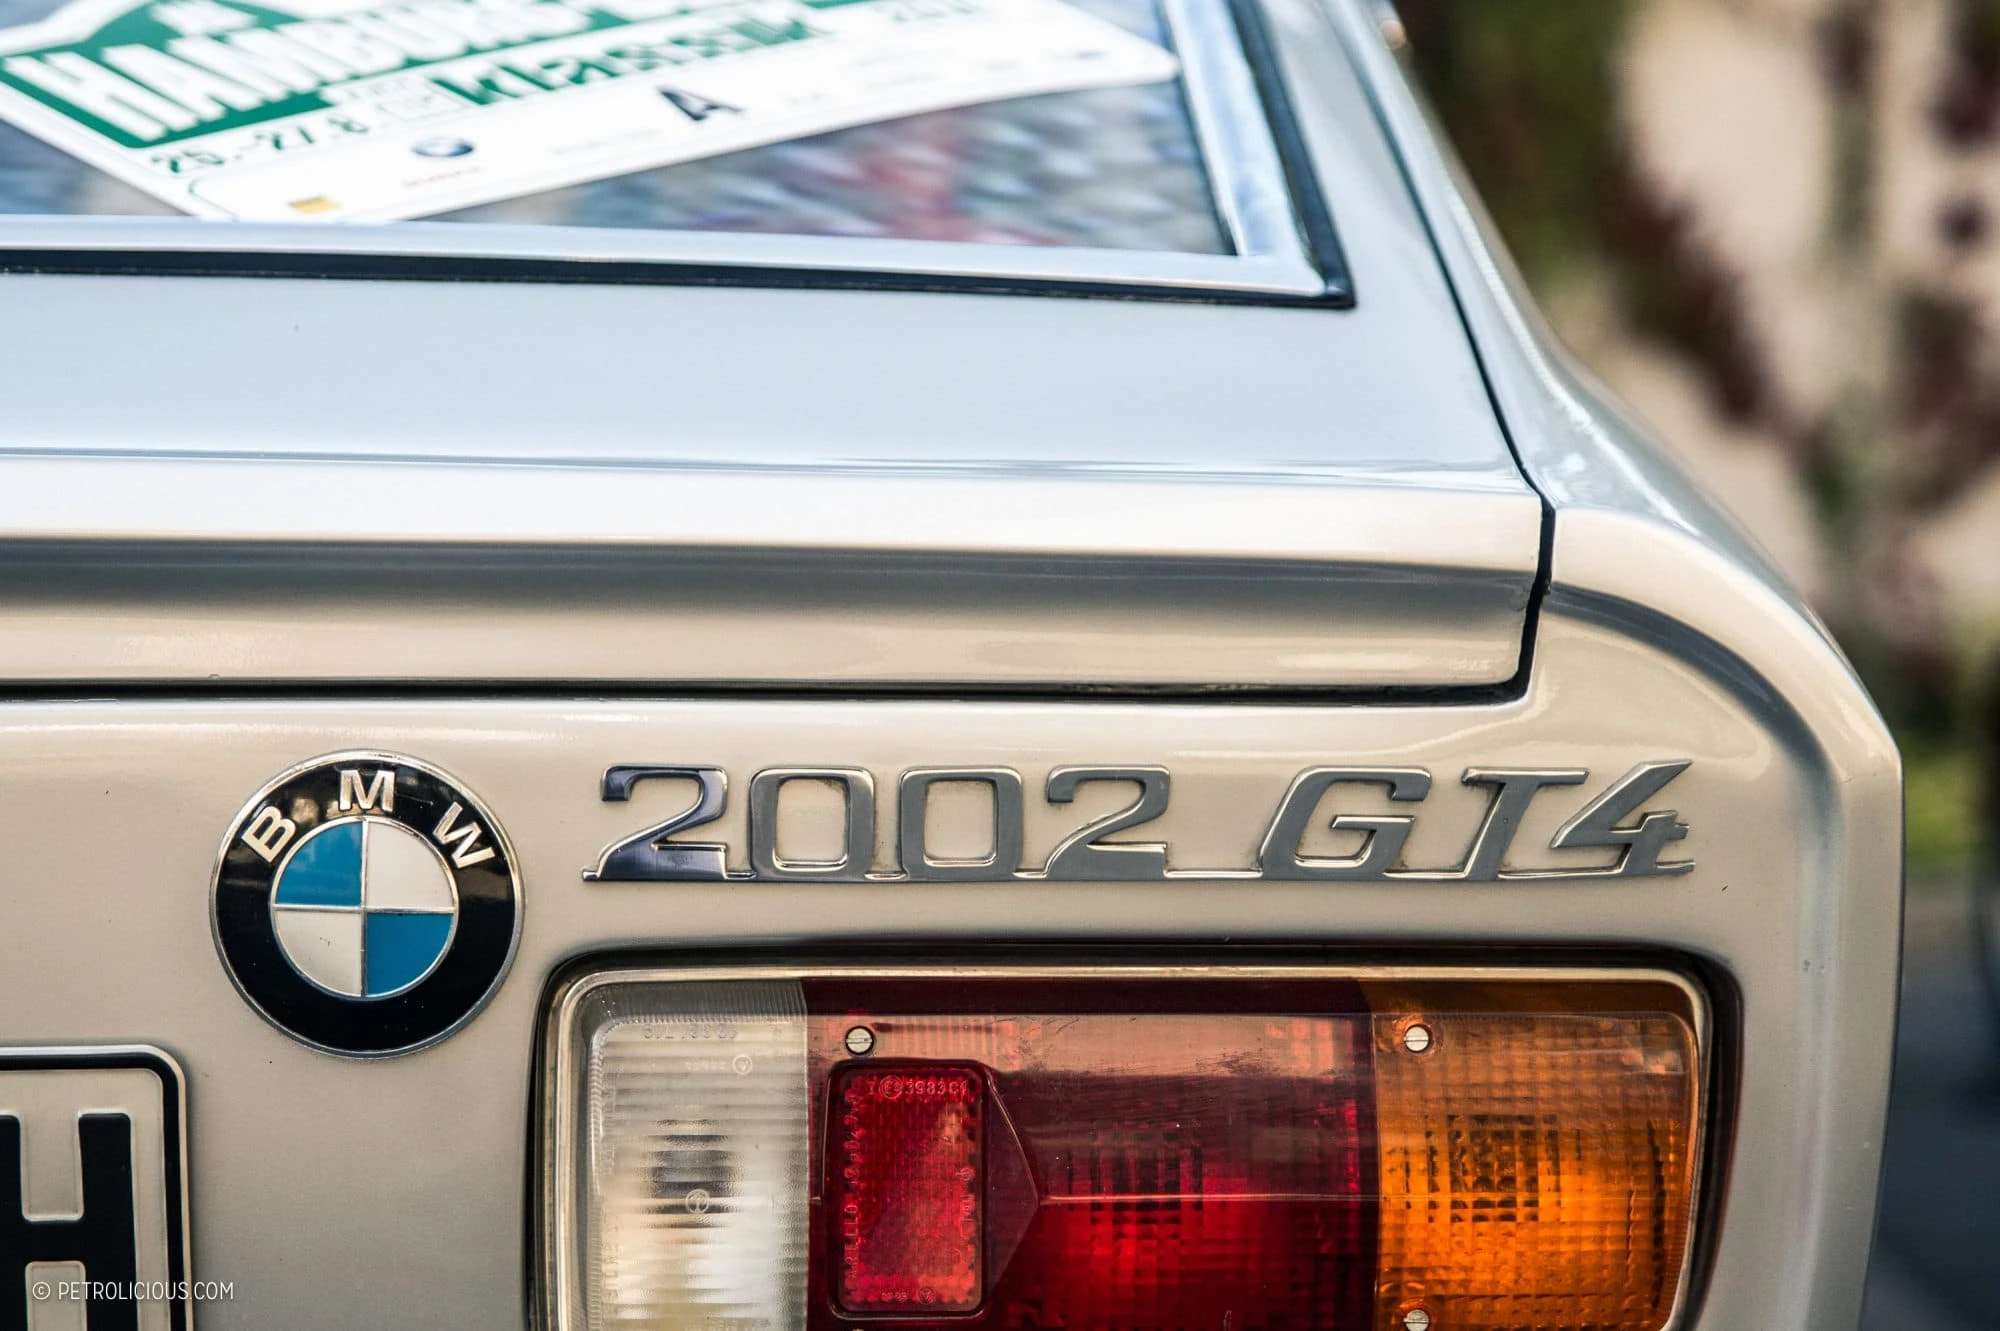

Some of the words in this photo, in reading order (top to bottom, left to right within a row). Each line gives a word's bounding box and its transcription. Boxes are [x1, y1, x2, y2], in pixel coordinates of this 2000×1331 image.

[656, 84, 745, 122] A
[241, 769, 495, 869] BMW
[583, 764, 1170, 882] 2002
[1257, 759, 1695, 882] GT4
[0, 1112, 139, 1331] H
